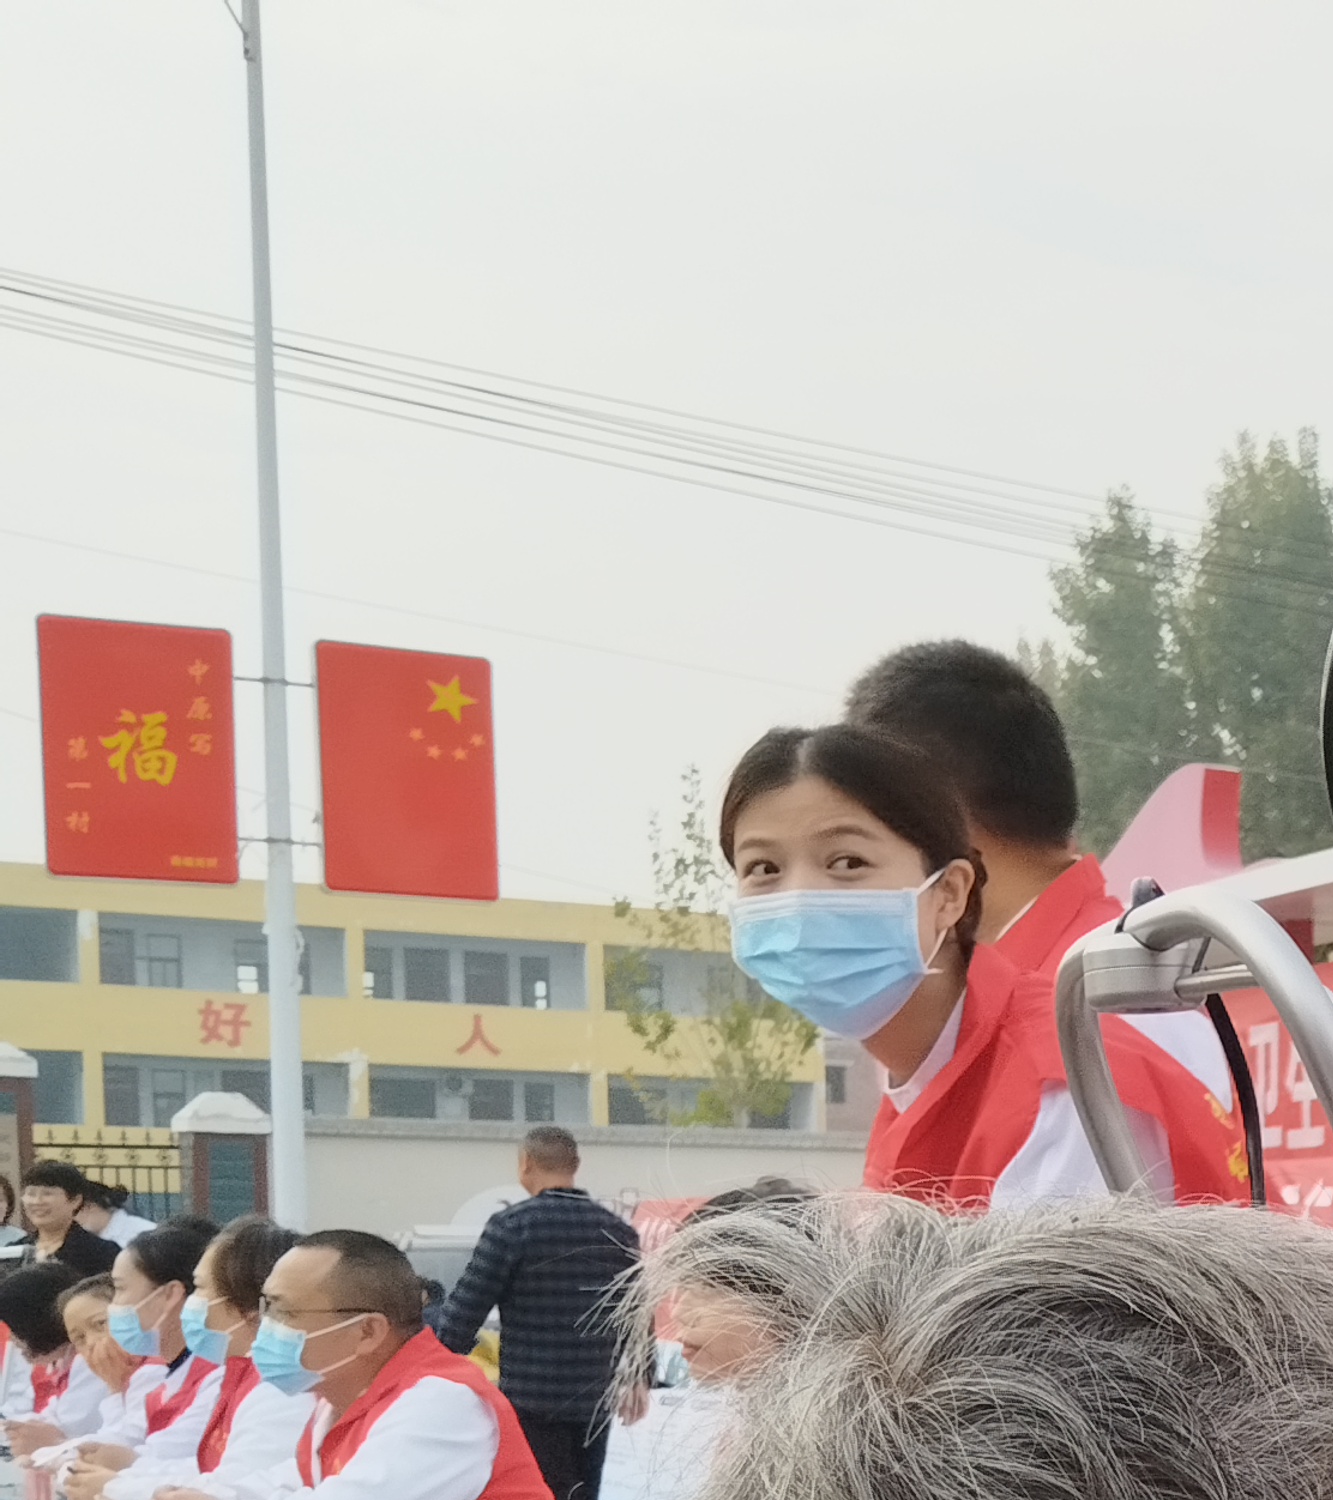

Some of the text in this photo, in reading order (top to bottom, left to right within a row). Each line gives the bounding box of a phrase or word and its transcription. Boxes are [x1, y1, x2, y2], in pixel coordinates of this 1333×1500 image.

[98, 708, 178, 786] 福
[198, 1000, 502, 1057] 好 人
